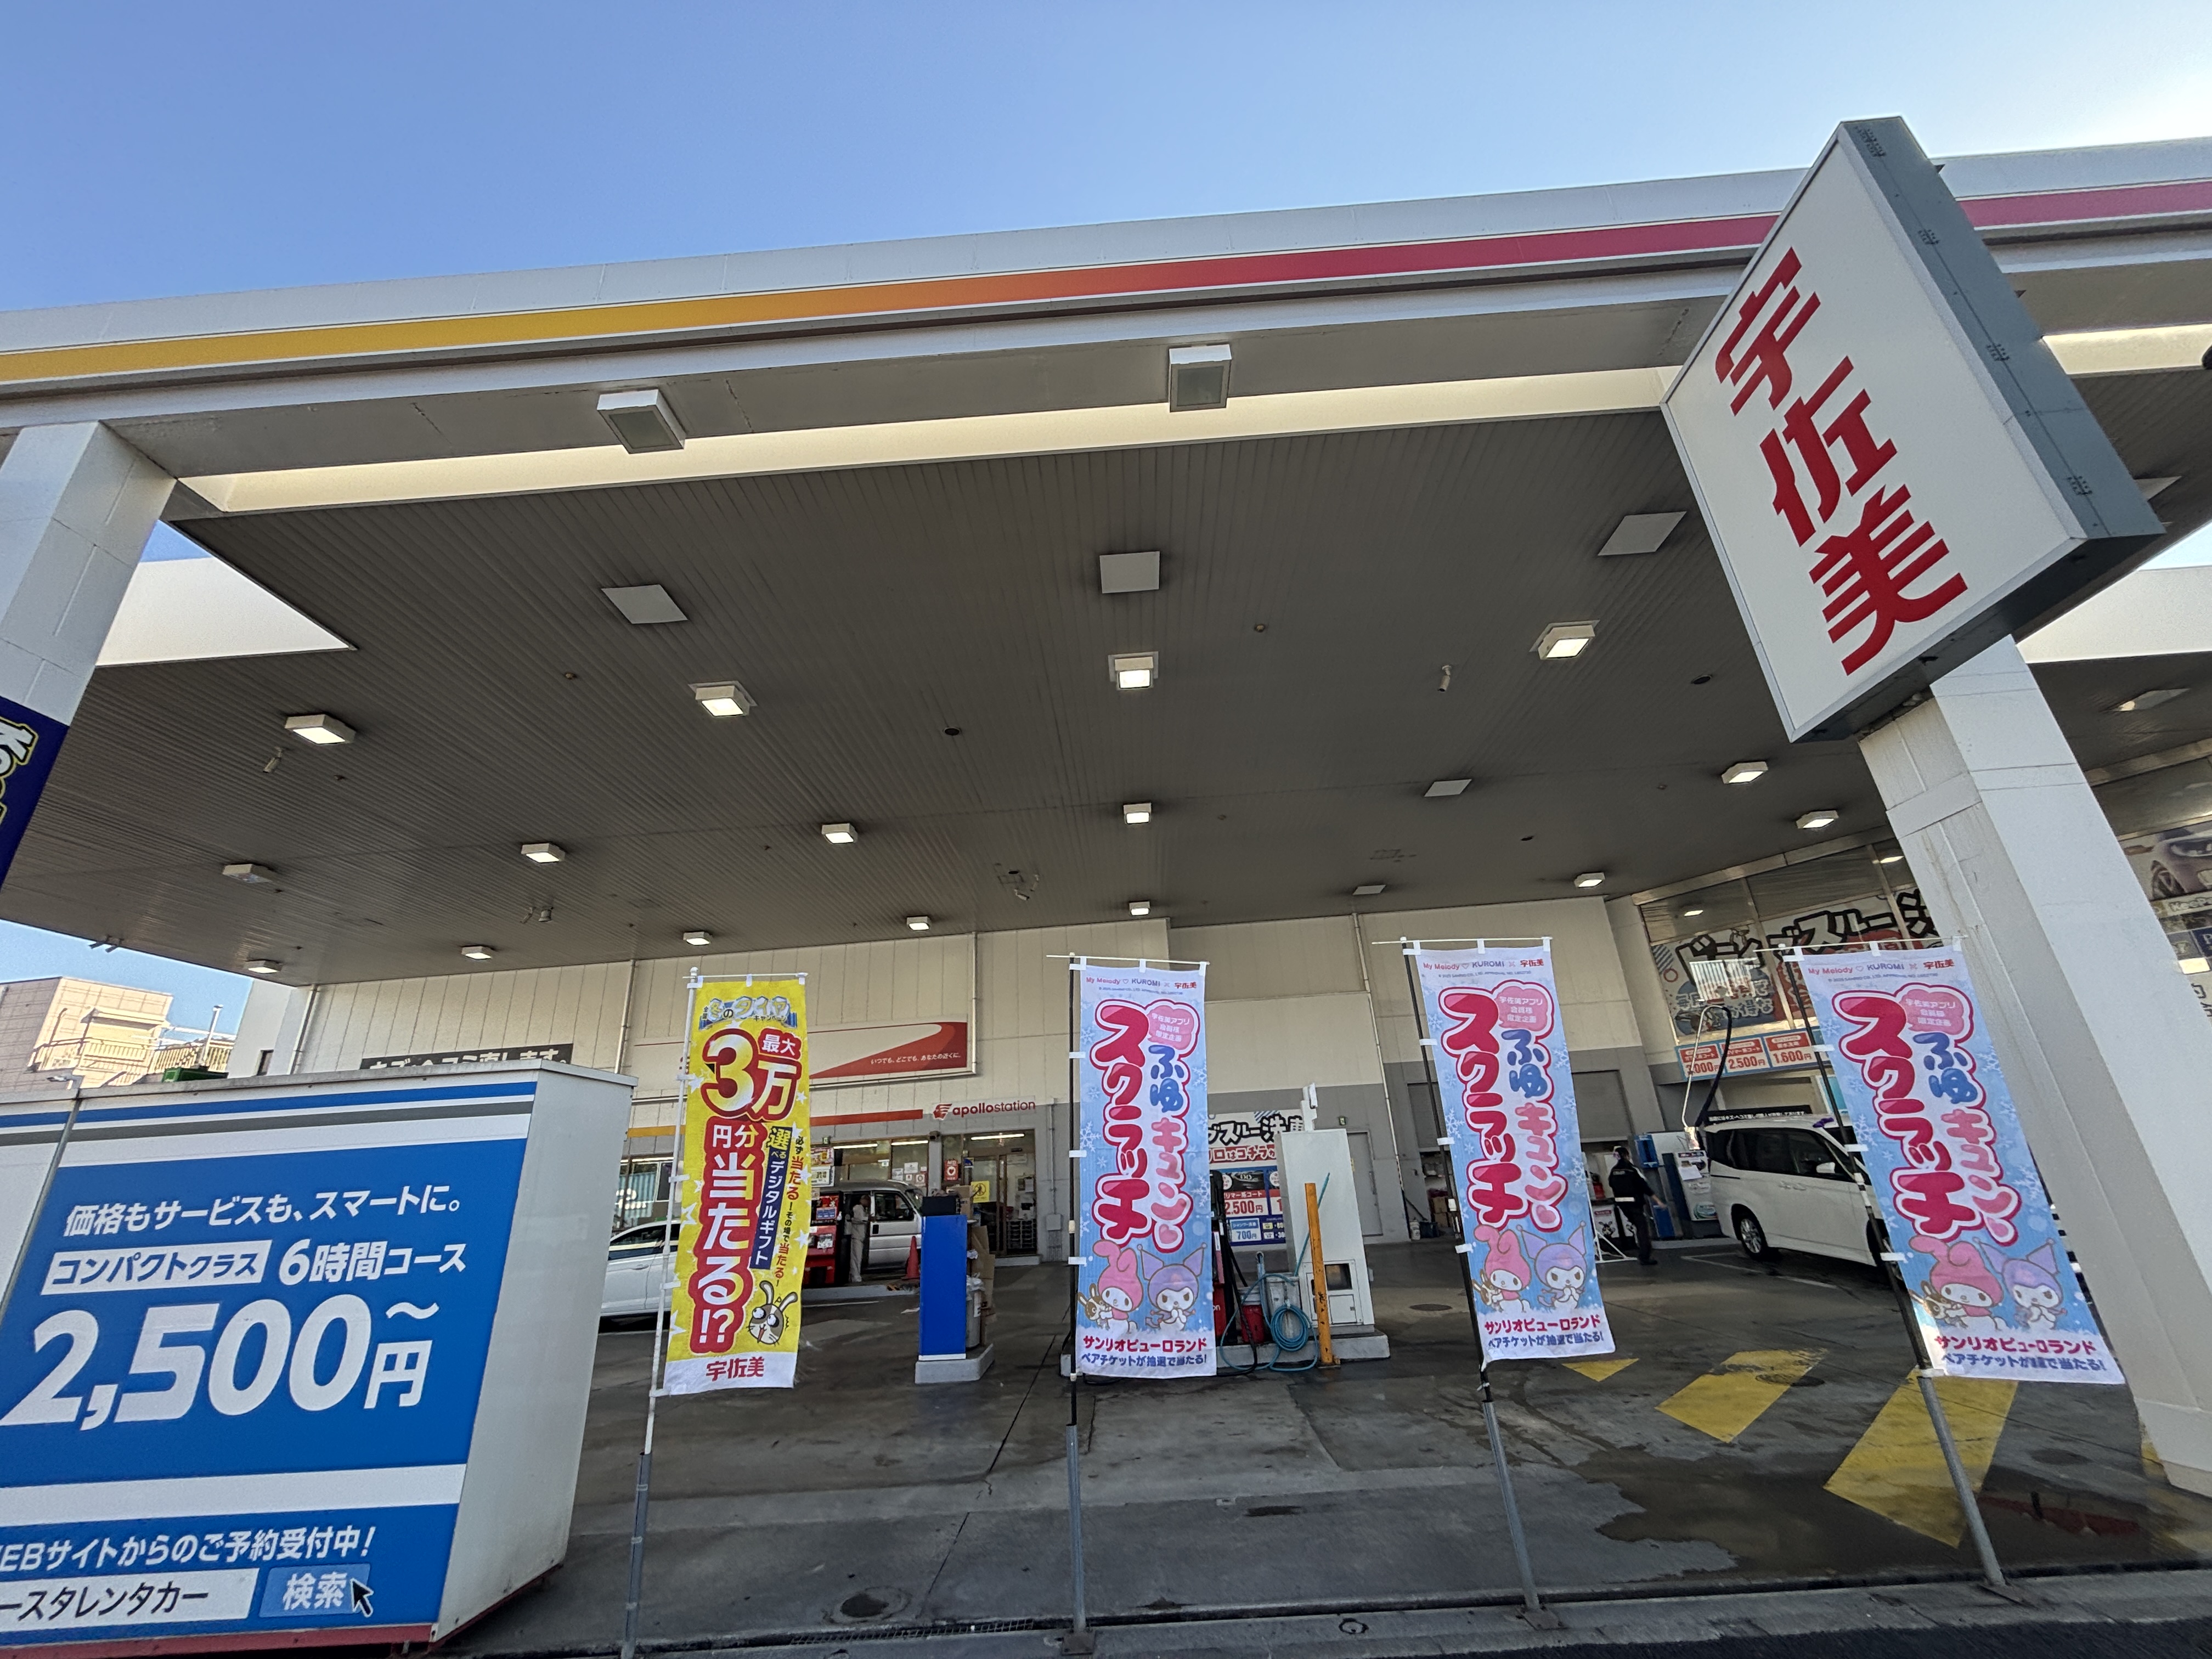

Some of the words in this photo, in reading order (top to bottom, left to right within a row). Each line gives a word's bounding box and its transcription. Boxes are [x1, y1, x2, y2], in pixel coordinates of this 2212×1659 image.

[1715, 246, 1968, 676] 宇佐美
[1520, 958, 1544, 967] 宇佐美
[1923, 959, 1955, 969] 宇佐美
[1131, 978, 1160, 986] KUROMI
[761, 1033, 795, 1056] 最大
[706, 1034, 797, 1115] 3万
[952, 1100, 1035, 1118] apollostation
[1444, 992, 1523, 1224] スクラッチ
[1838, 996, 1976, 1234] スクラッチ
[1094, 1004, 1150, 1241] スクラッチ
[713, 1125, 759, 1148] 円分
[63, 1184, 461, 1238] 価格もサービスも、スマートに。
[1236, 1231, 1257, 1240] 700円
[52, 1251, 262, 1286] コンパクトクラス
[278, 1238, 467, 1286] 6時間コース
[1484, 1314, 1601, 1335] サンリオピューロランド
[1083, 1335, 1207, 1352] サンリオピューロランド
[1934, 1336, 2096, 1355] サンリオピューロランド
[706, 1356, 765, 1381] 宇佐美
[0, 1526, 376, 1572] EBサイトからのご予約受付中!
[282, 1571, 348, 1610] 検索
